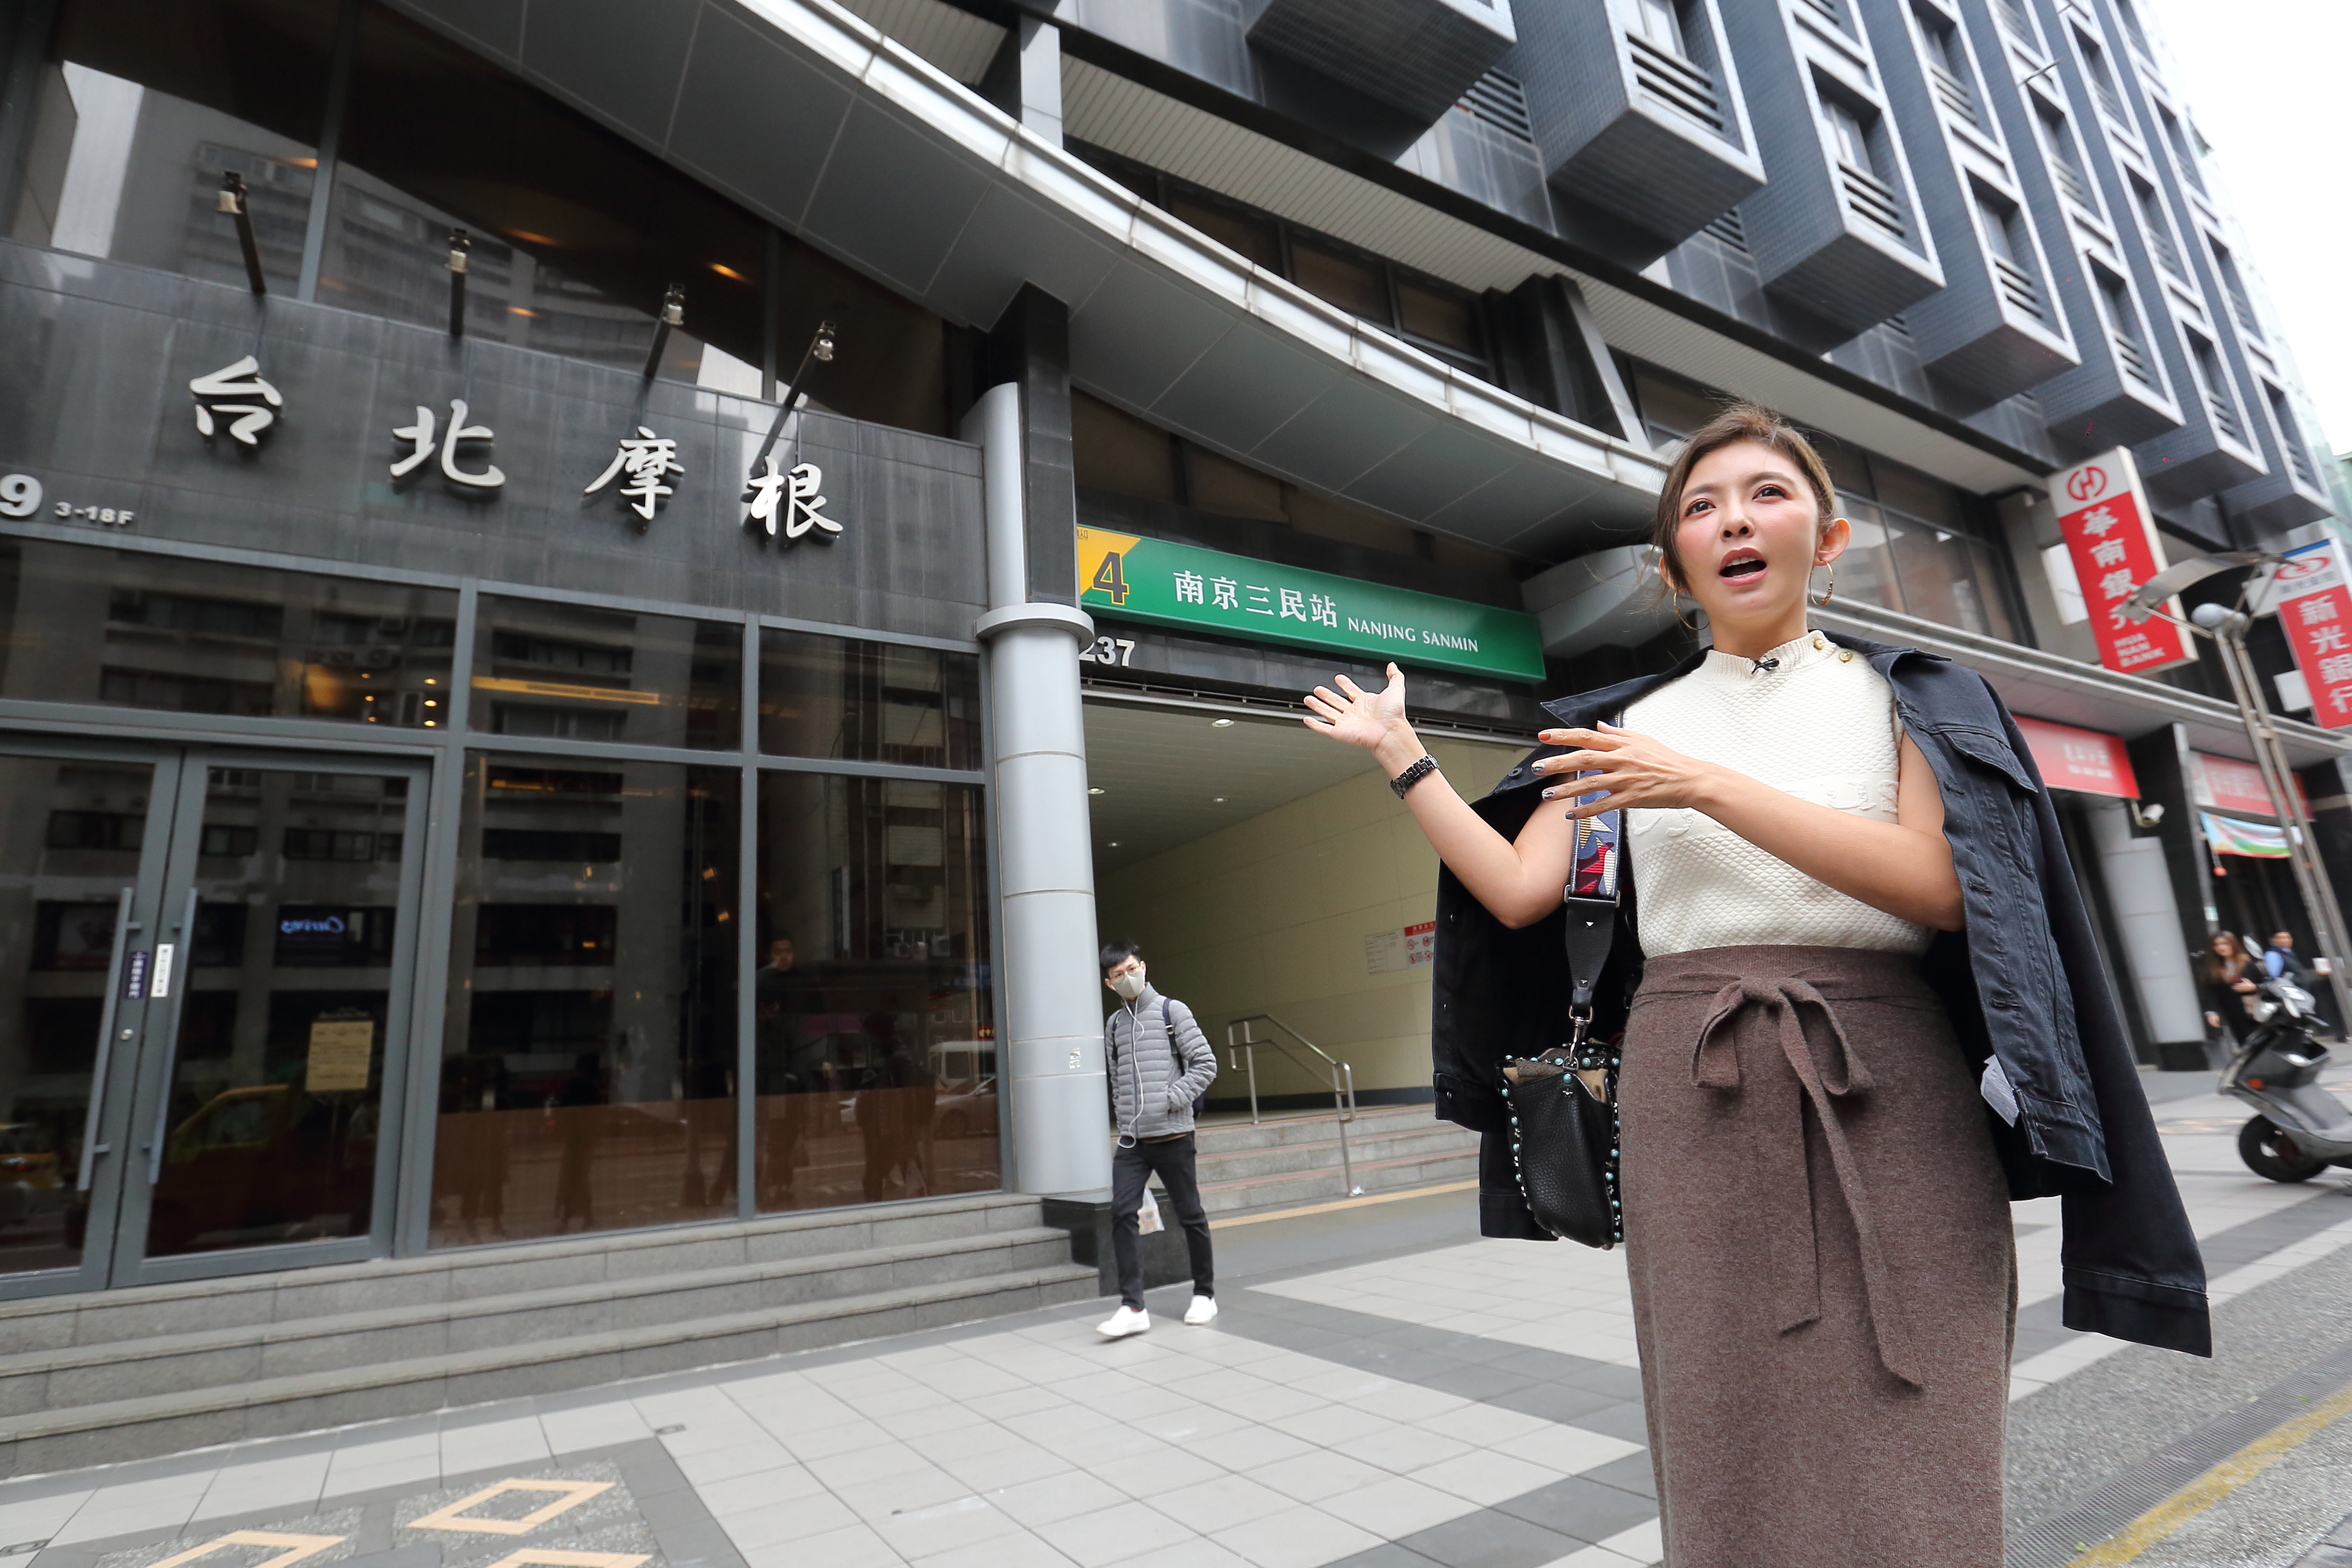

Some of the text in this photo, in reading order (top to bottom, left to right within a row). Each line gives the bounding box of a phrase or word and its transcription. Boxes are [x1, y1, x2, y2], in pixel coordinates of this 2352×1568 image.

[189, 355, 843, 538] 台北摩根
[54, 501, 134, 524] 3-18F
[1092, 551, 1130, 606] 4
[1173, 570, 1338, 628] 南京三民站
[1347, 617, 1478, 653] NANJING SANMIN
[2120, 646, 2166, 668] BANK
